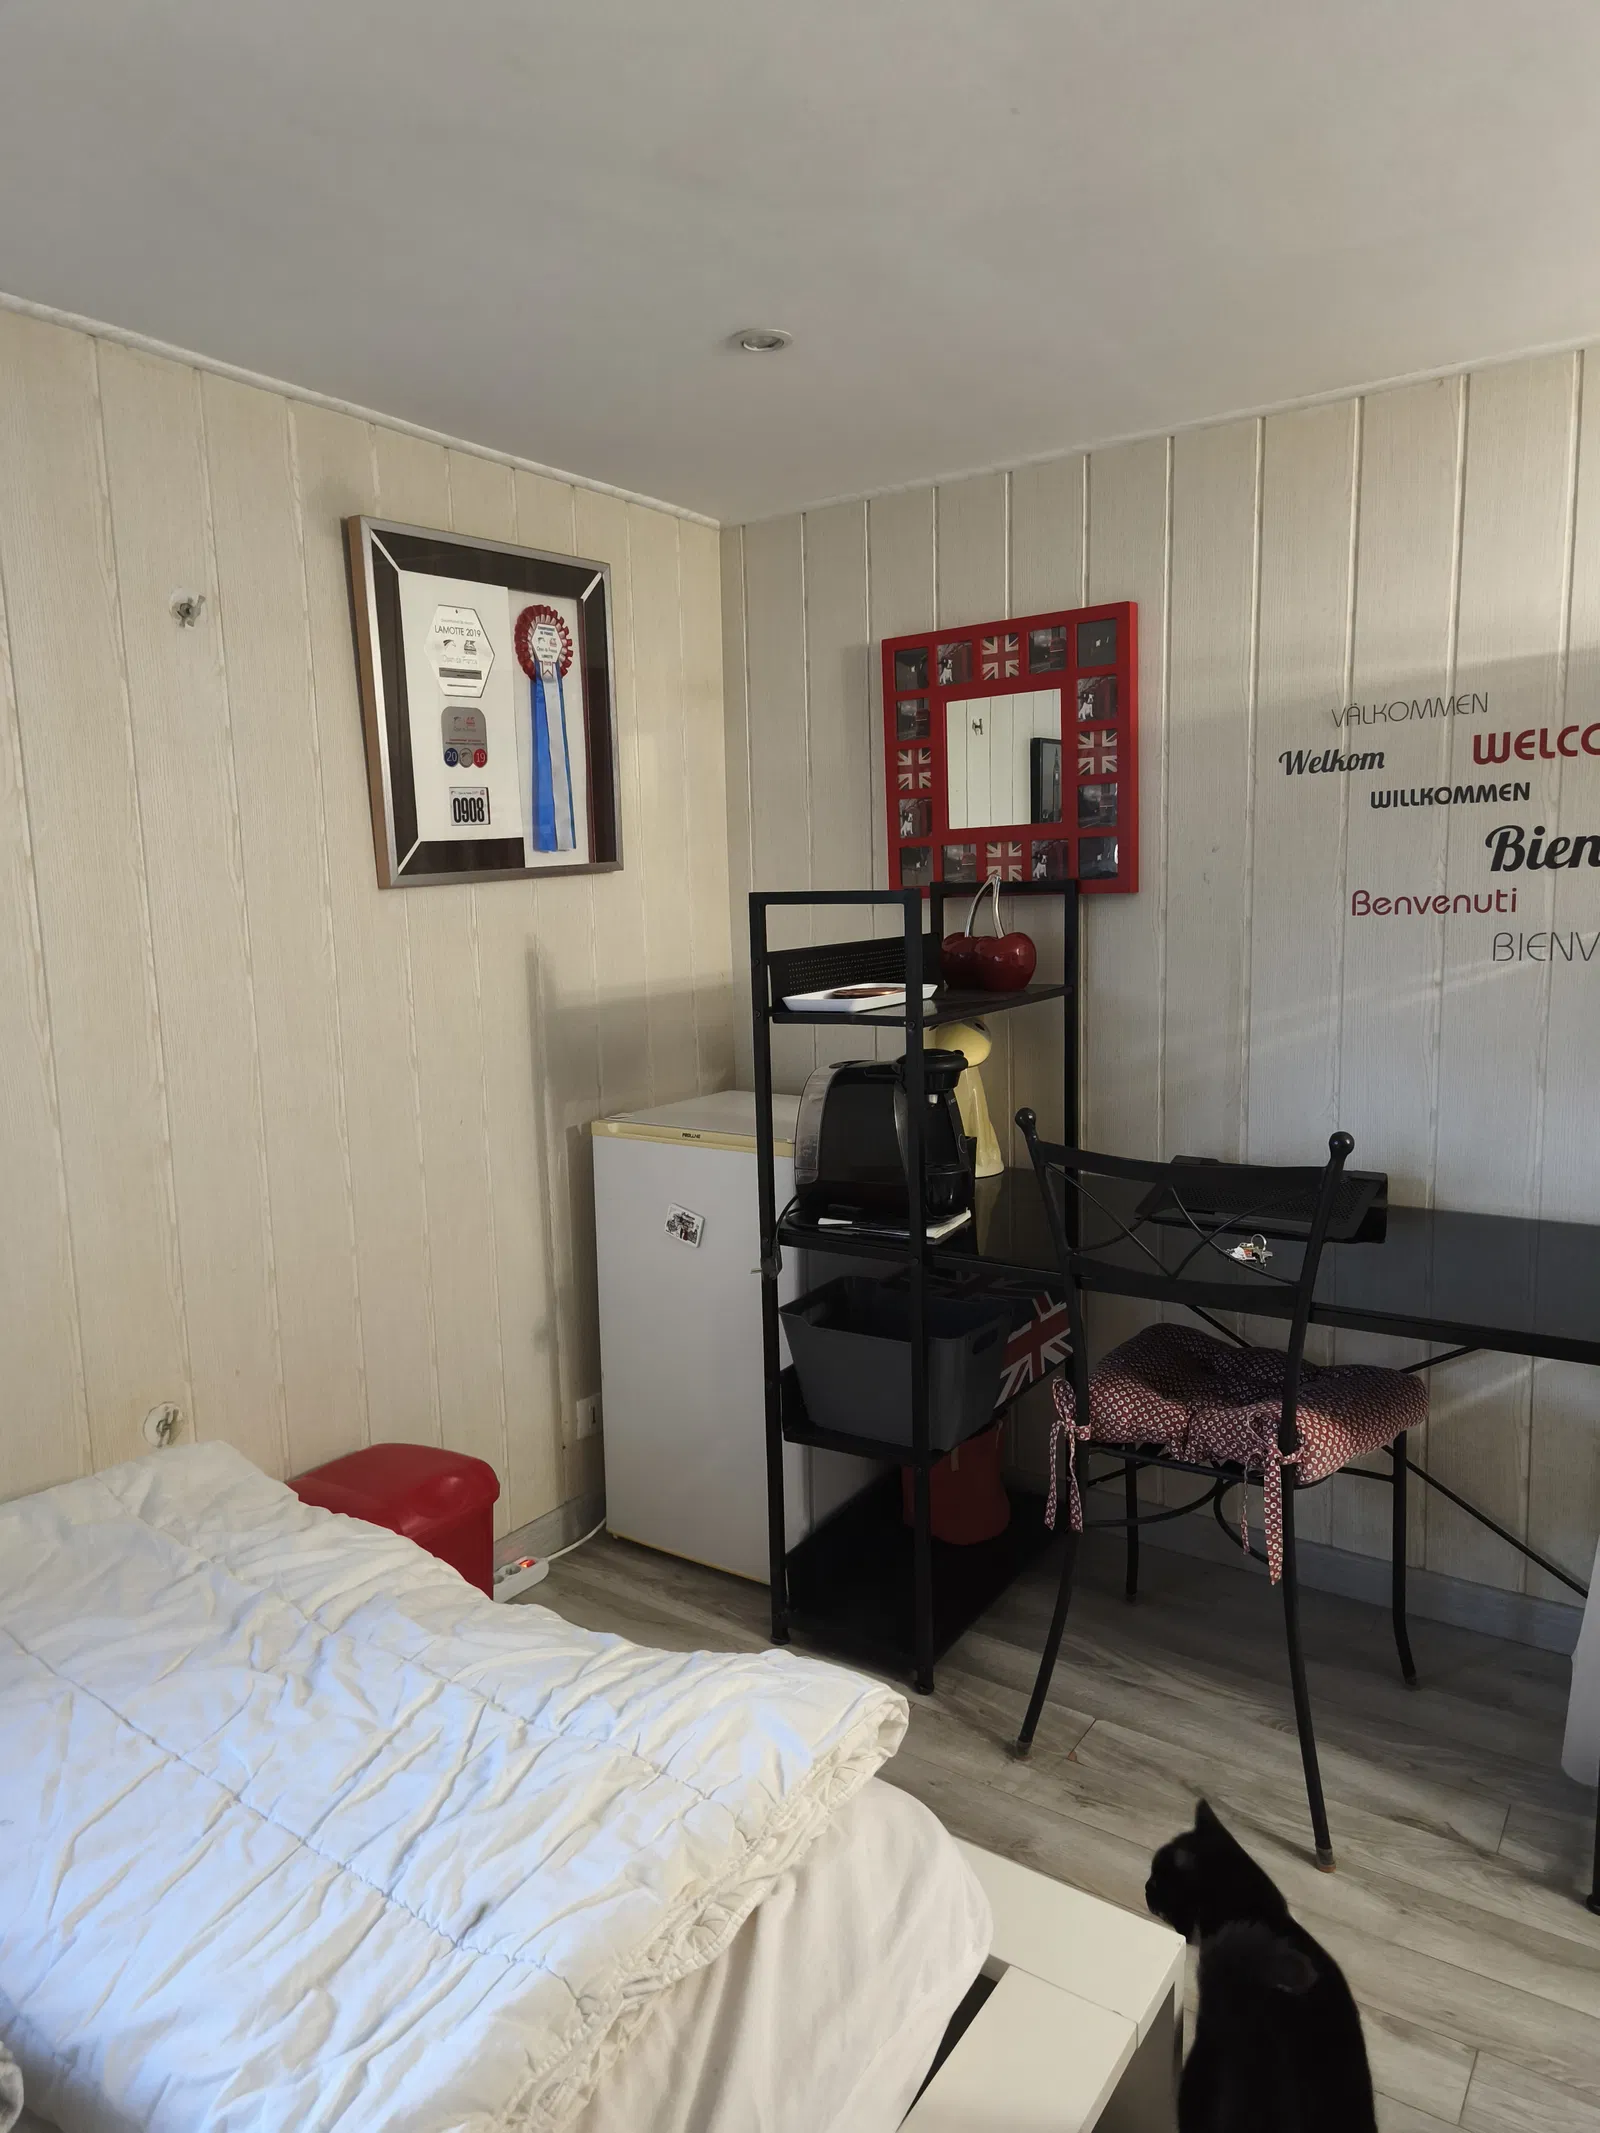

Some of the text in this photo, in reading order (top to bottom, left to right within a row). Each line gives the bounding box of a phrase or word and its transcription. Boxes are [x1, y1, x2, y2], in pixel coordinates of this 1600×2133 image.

[434, 625, 481, 637] LAMOTTE 2019
[1331, 692, 1488, 728] VÄLKOMMEN
[446, 751, 457, 762] 20
[476, 752, 486, 763] 19
[1278, 749, 1385, 775] Welkom
[1370, 782, 1530, 809] WILLKOMMEN
[453, 797, 485, 823] 0908
[1485, 824, 1600, 872] Bien
[1352, 887, 1517, 916] Benvenuti
[1492, 931, 1600, 961] BIENV
